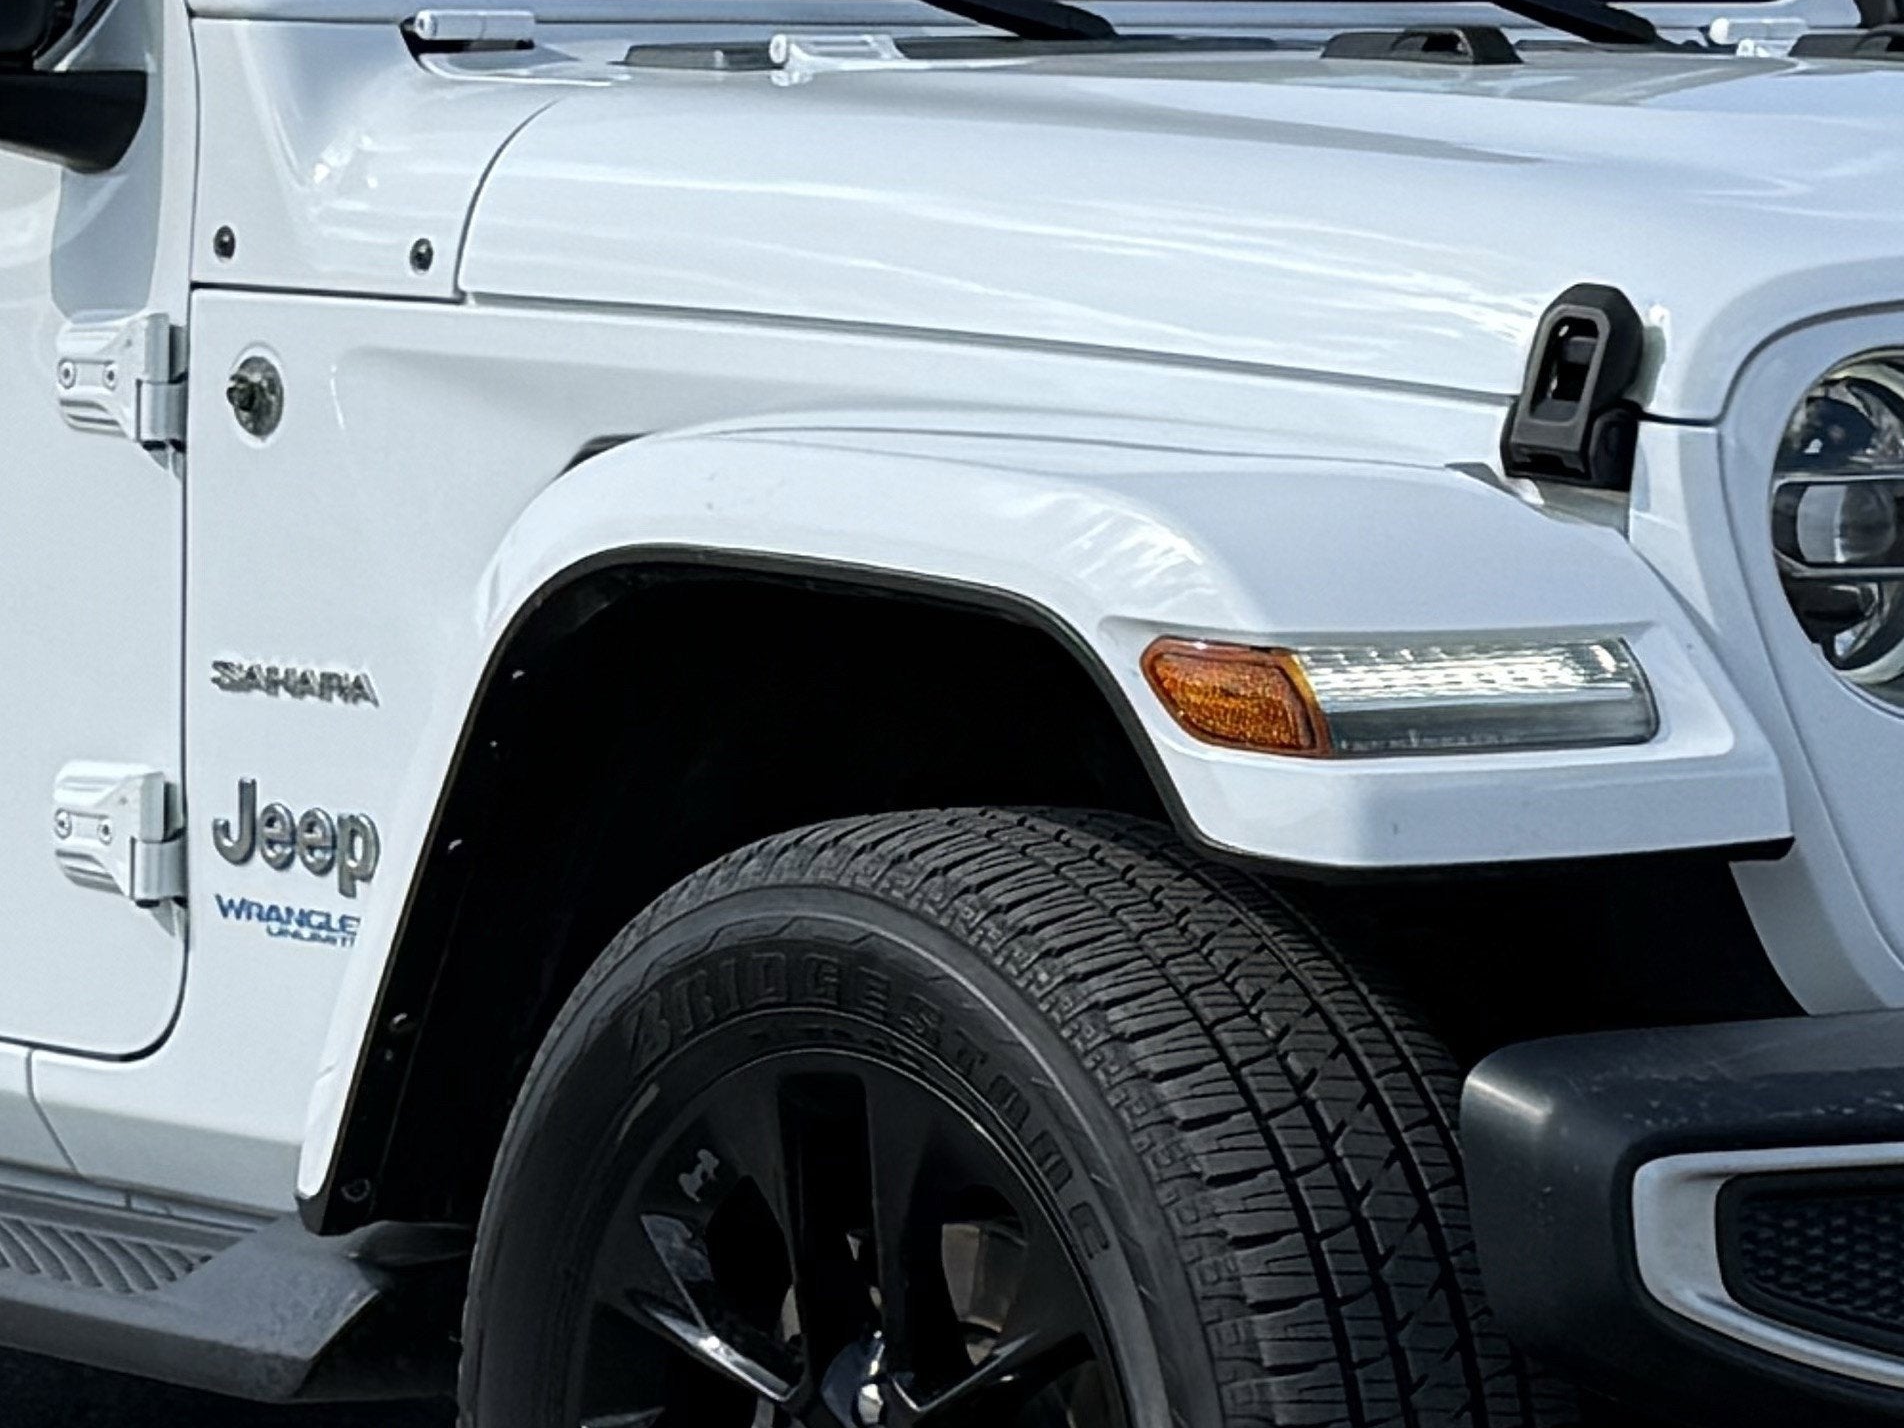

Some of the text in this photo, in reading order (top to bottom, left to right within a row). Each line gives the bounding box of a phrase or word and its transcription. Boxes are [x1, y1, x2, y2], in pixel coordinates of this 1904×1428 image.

[209, 659, 380, 708] SAHARA
[211, 776, 382, 899] Jeep
[622, 948, 1114, 1262] BRIDGESTONE
